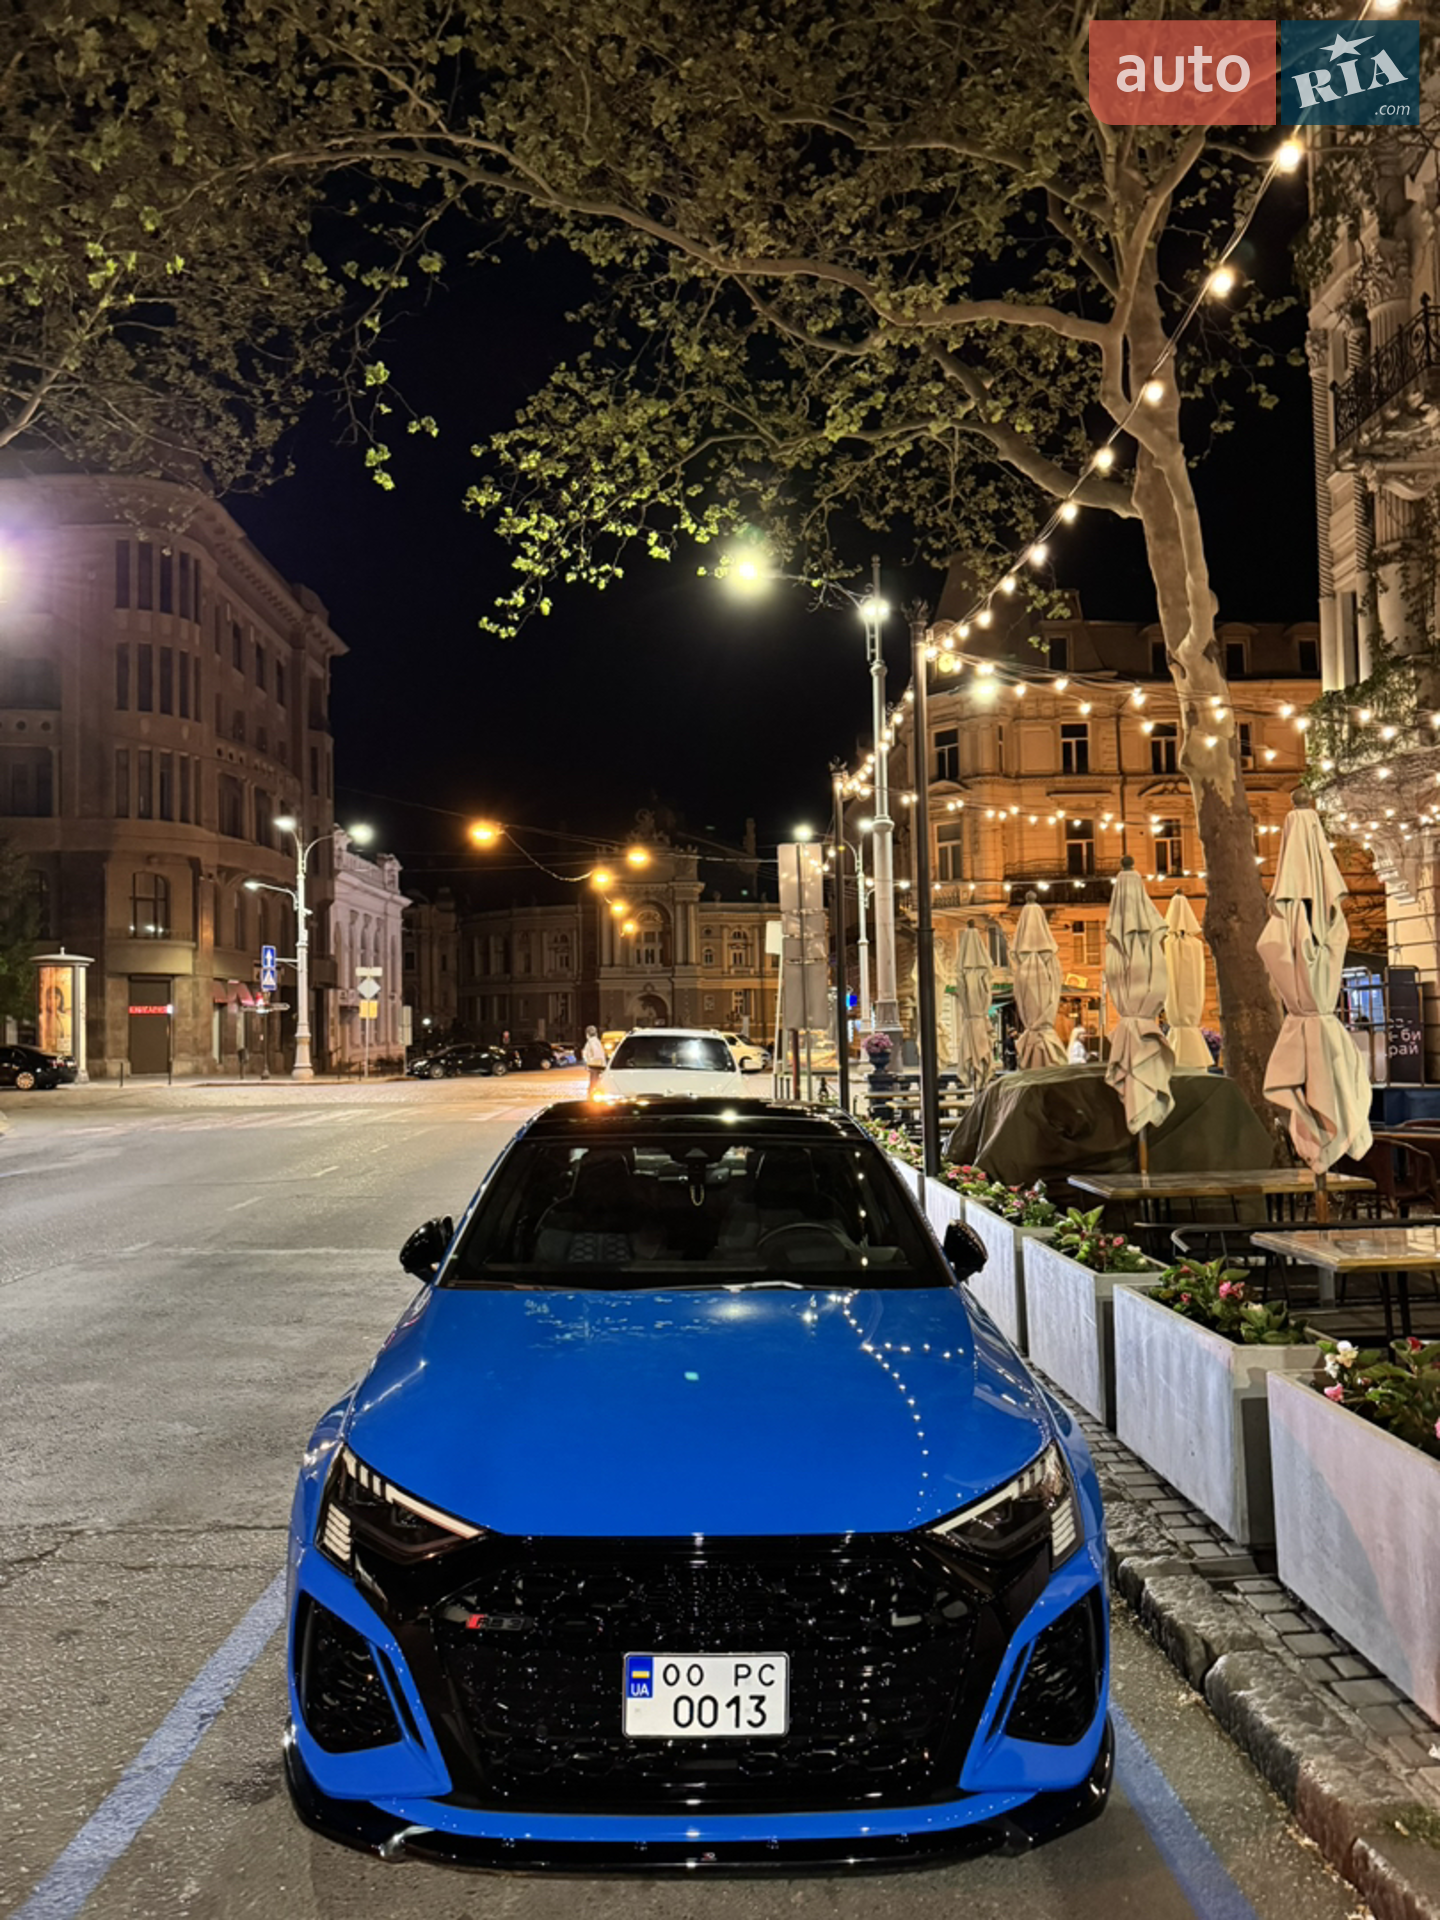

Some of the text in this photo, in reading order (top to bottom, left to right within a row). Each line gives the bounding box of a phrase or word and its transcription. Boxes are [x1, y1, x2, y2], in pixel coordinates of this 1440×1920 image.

[1388, 1041, 1420, 1058] рай
[734, 1663, 775, 1687] PC
[630, 1683, 650, 1697] UA
[673, 1695, 767, 1729] 0013
